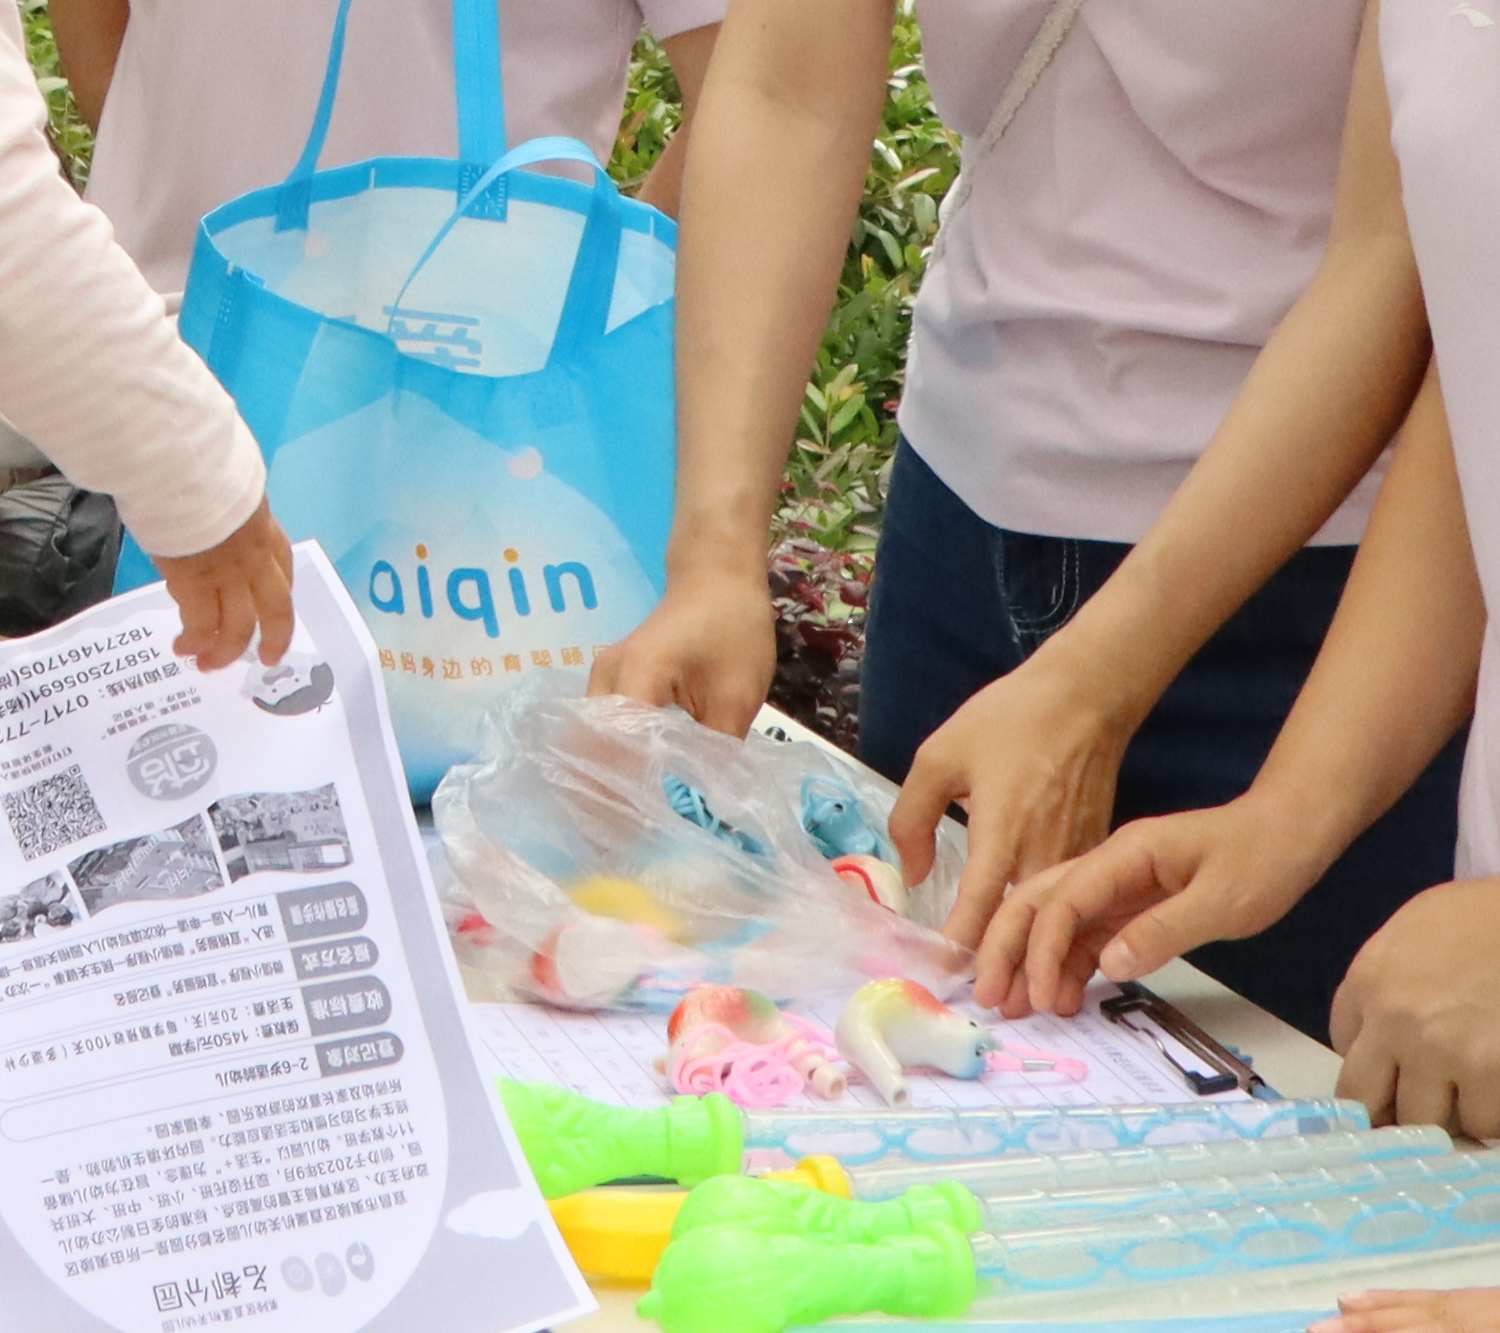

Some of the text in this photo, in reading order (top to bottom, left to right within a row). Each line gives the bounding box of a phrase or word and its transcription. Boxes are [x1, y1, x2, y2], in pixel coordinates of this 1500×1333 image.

[369, 543, 598, 638] aiqin
[300, 940, 371, 973] 报名方式
[309, 986, 384, 1022] 收费标准
[324, 1036, 395, 1069] 登记对象
[151, 1262, 271, 1313] 名都分园
